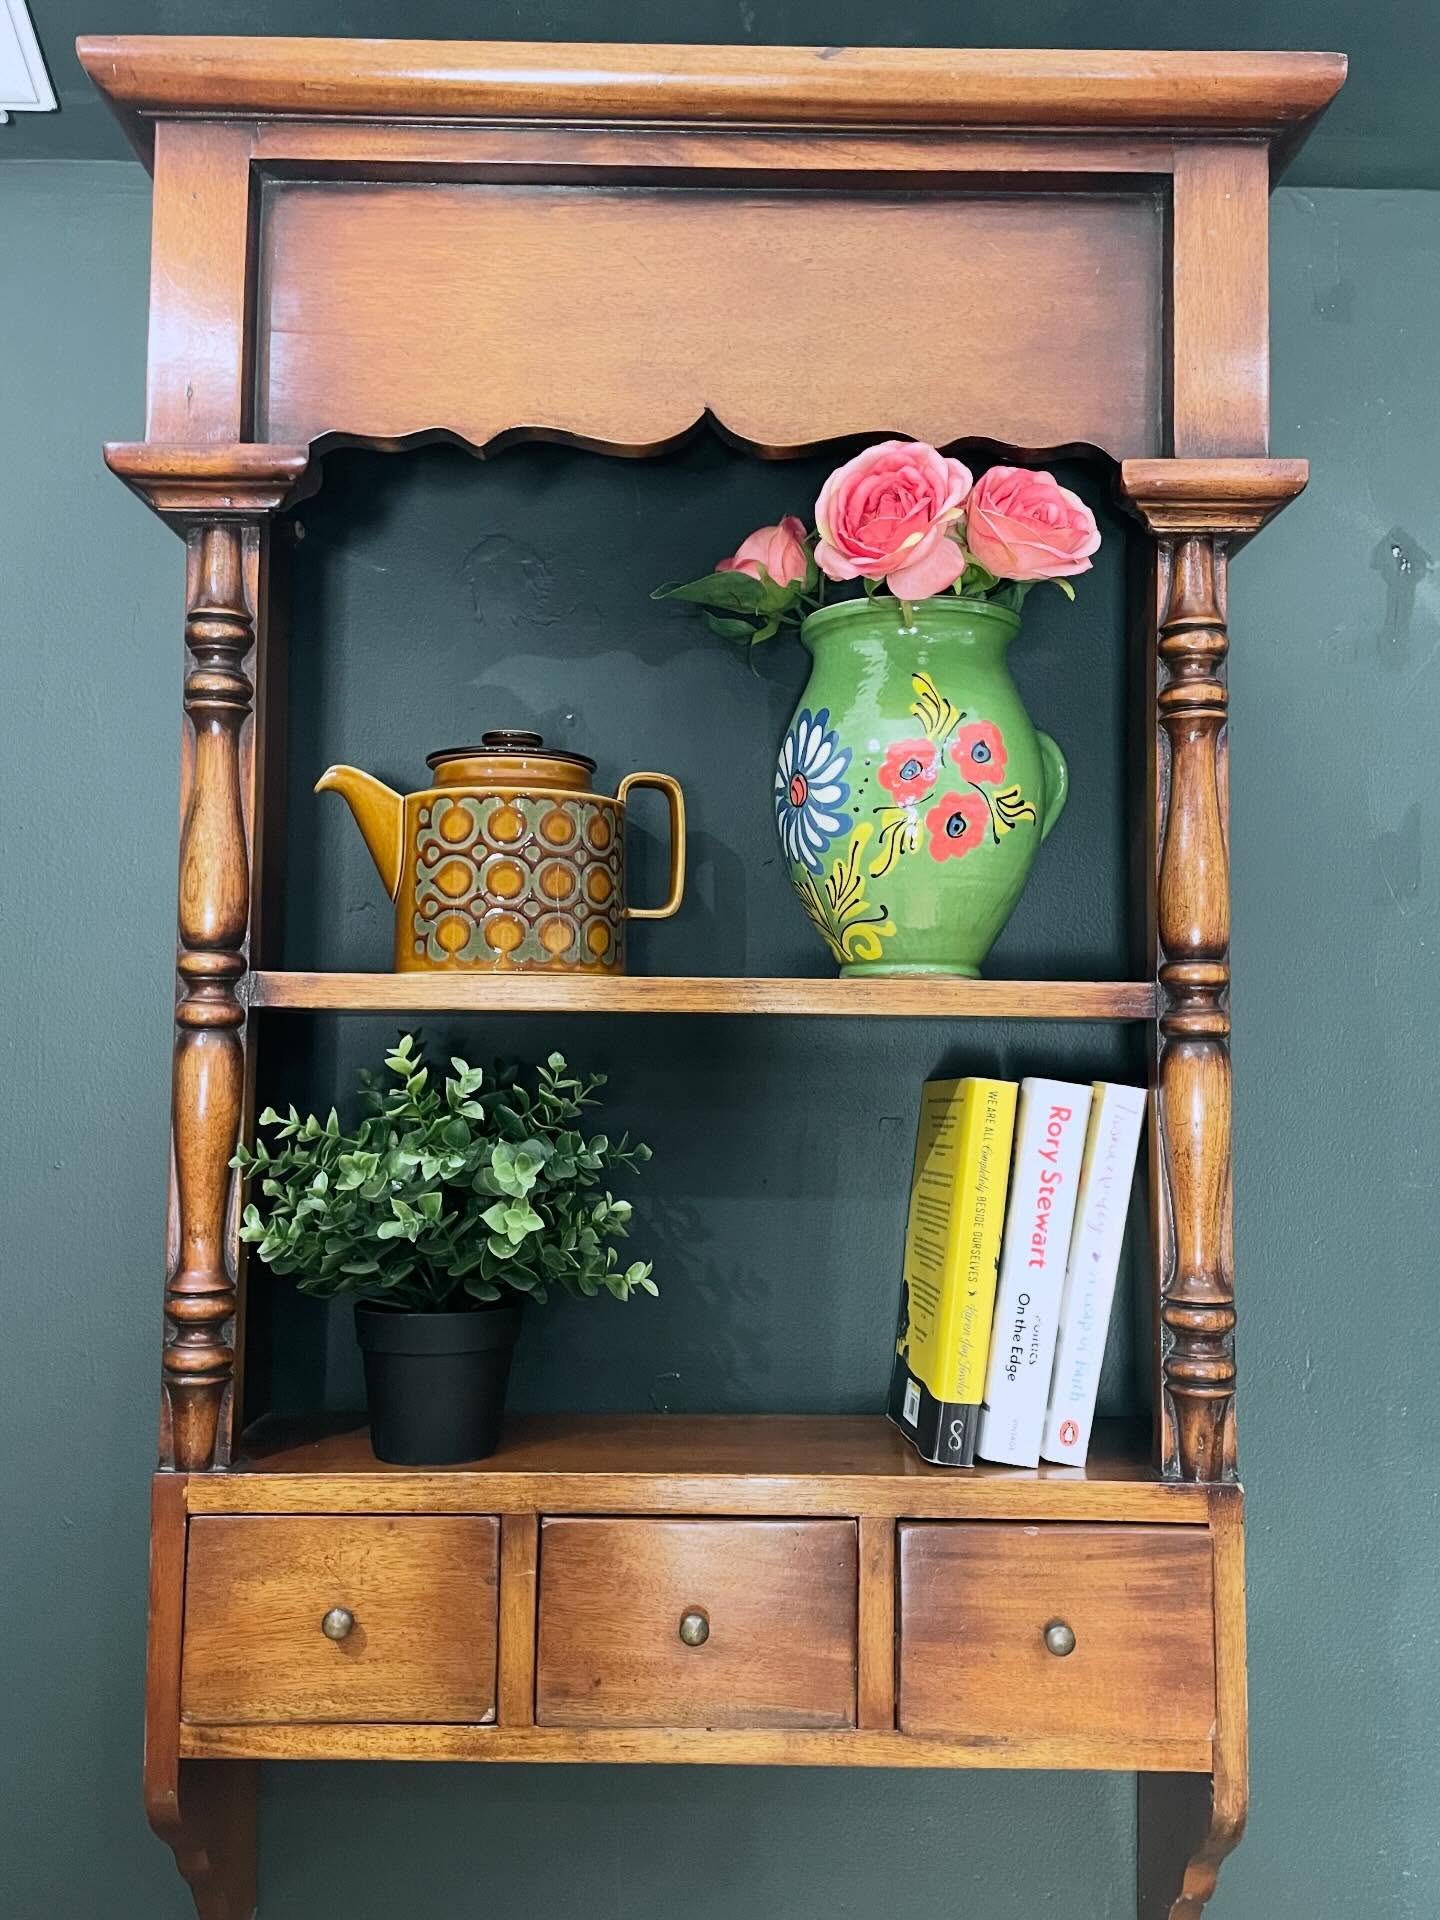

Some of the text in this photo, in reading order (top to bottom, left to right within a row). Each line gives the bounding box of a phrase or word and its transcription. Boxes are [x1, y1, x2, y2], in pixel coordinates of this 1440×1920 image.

[967, 1091, 999, 1283] WE ARE ALL Completely BESIDE OURSELVES
[1028, 1105, 1073, 1270] Rory Stewart
[1006, 1293, 1031, 1382] On the Edge
